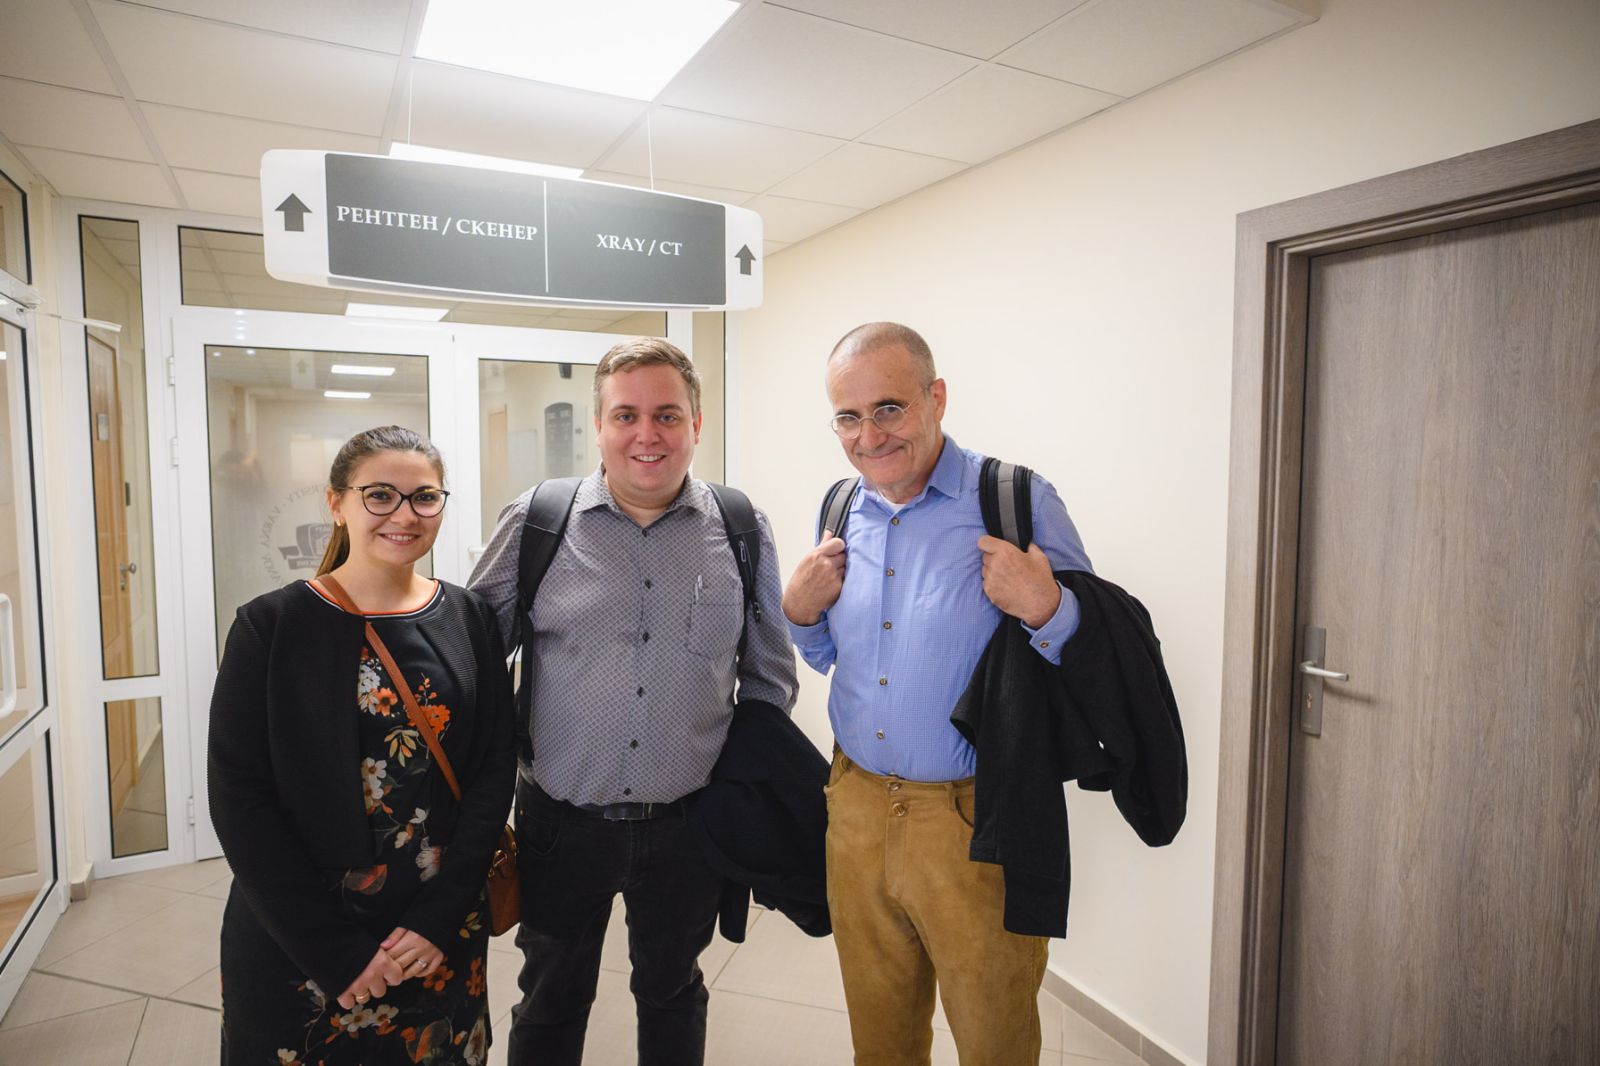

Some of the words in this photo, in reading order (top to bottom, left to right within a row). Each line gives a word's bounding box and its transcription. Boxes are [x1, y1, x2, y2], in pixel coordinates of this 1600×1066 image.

[336, 205, 438, 231] РЕНТГЕН
[456, 218, 538, 241] СКЕНЕР
[596, 233, 646, 252] XRAY
[659, 241, 683, 256] CT
